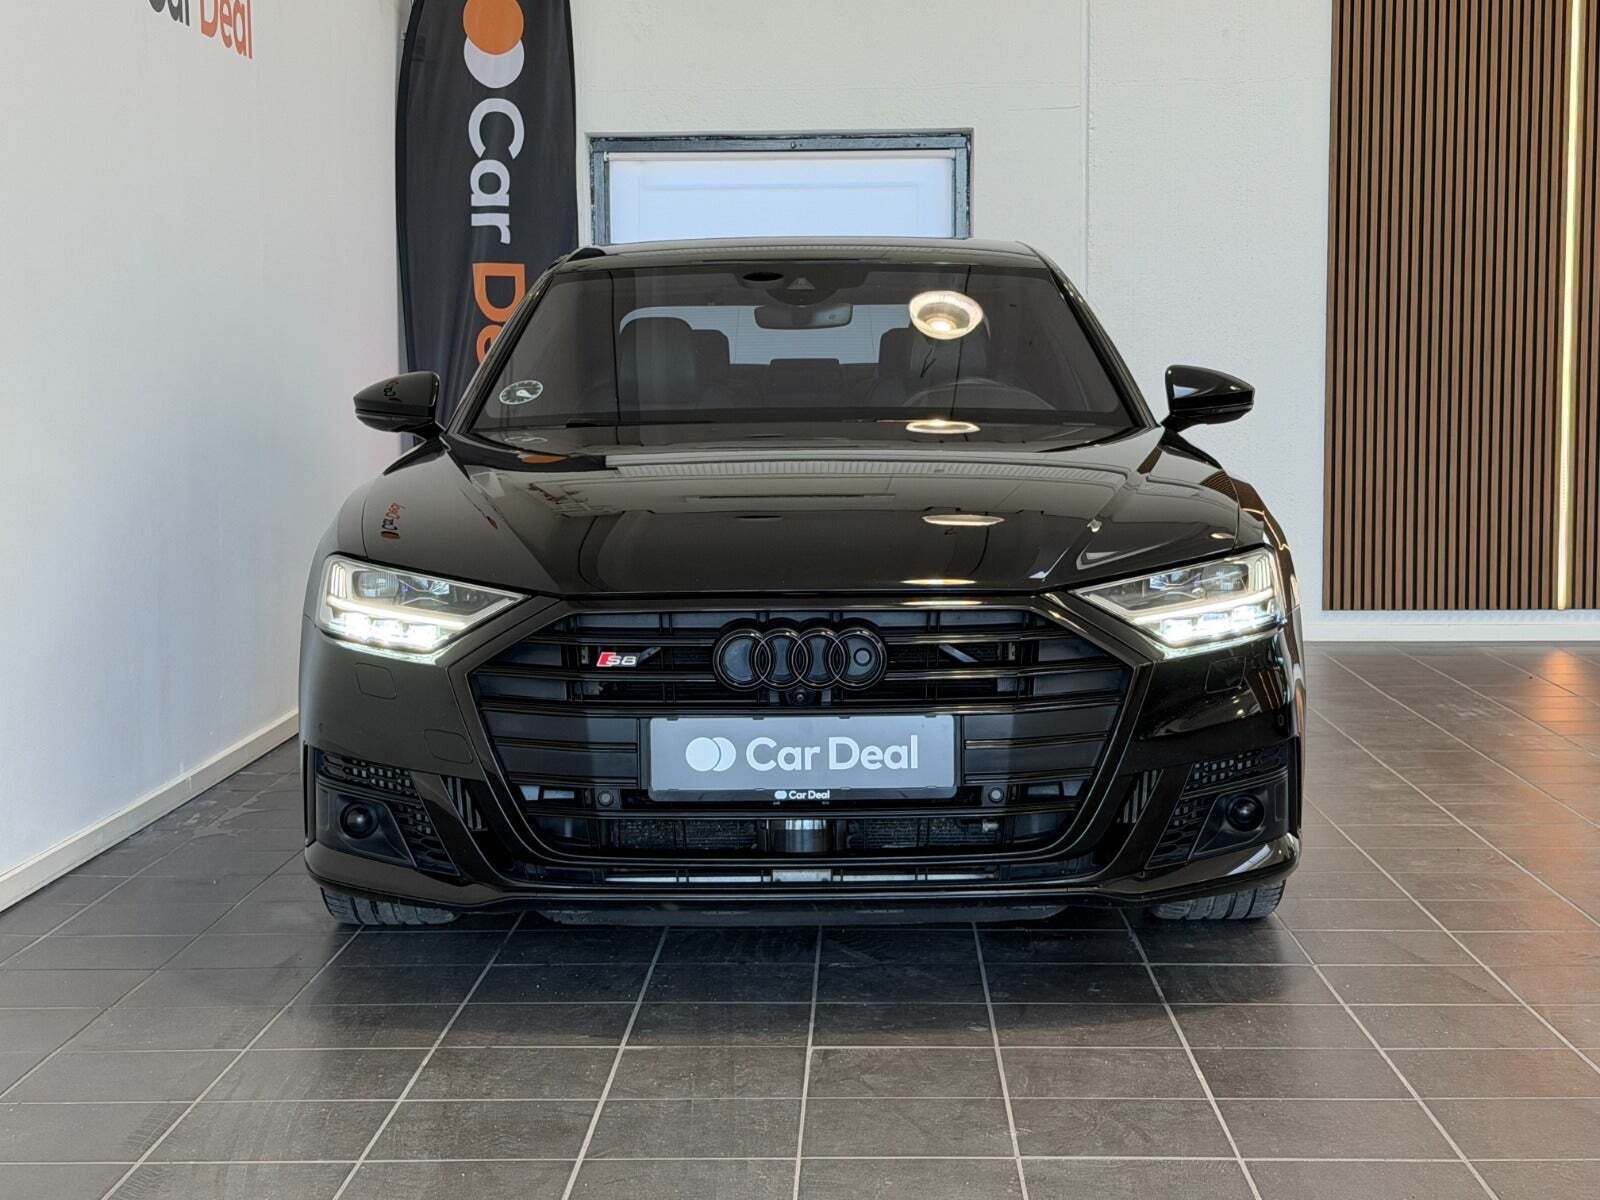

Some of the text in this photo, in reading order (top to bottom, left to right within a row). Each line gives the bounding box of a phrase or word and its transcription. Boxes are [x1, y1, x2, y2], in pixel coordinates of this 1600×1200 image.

[468, 97, 524, 245] Car
[605, 655, 638, 666] S8
[745, 734, 919, 772] Car Deal
[788, 789, 831, 800] Car Deal
